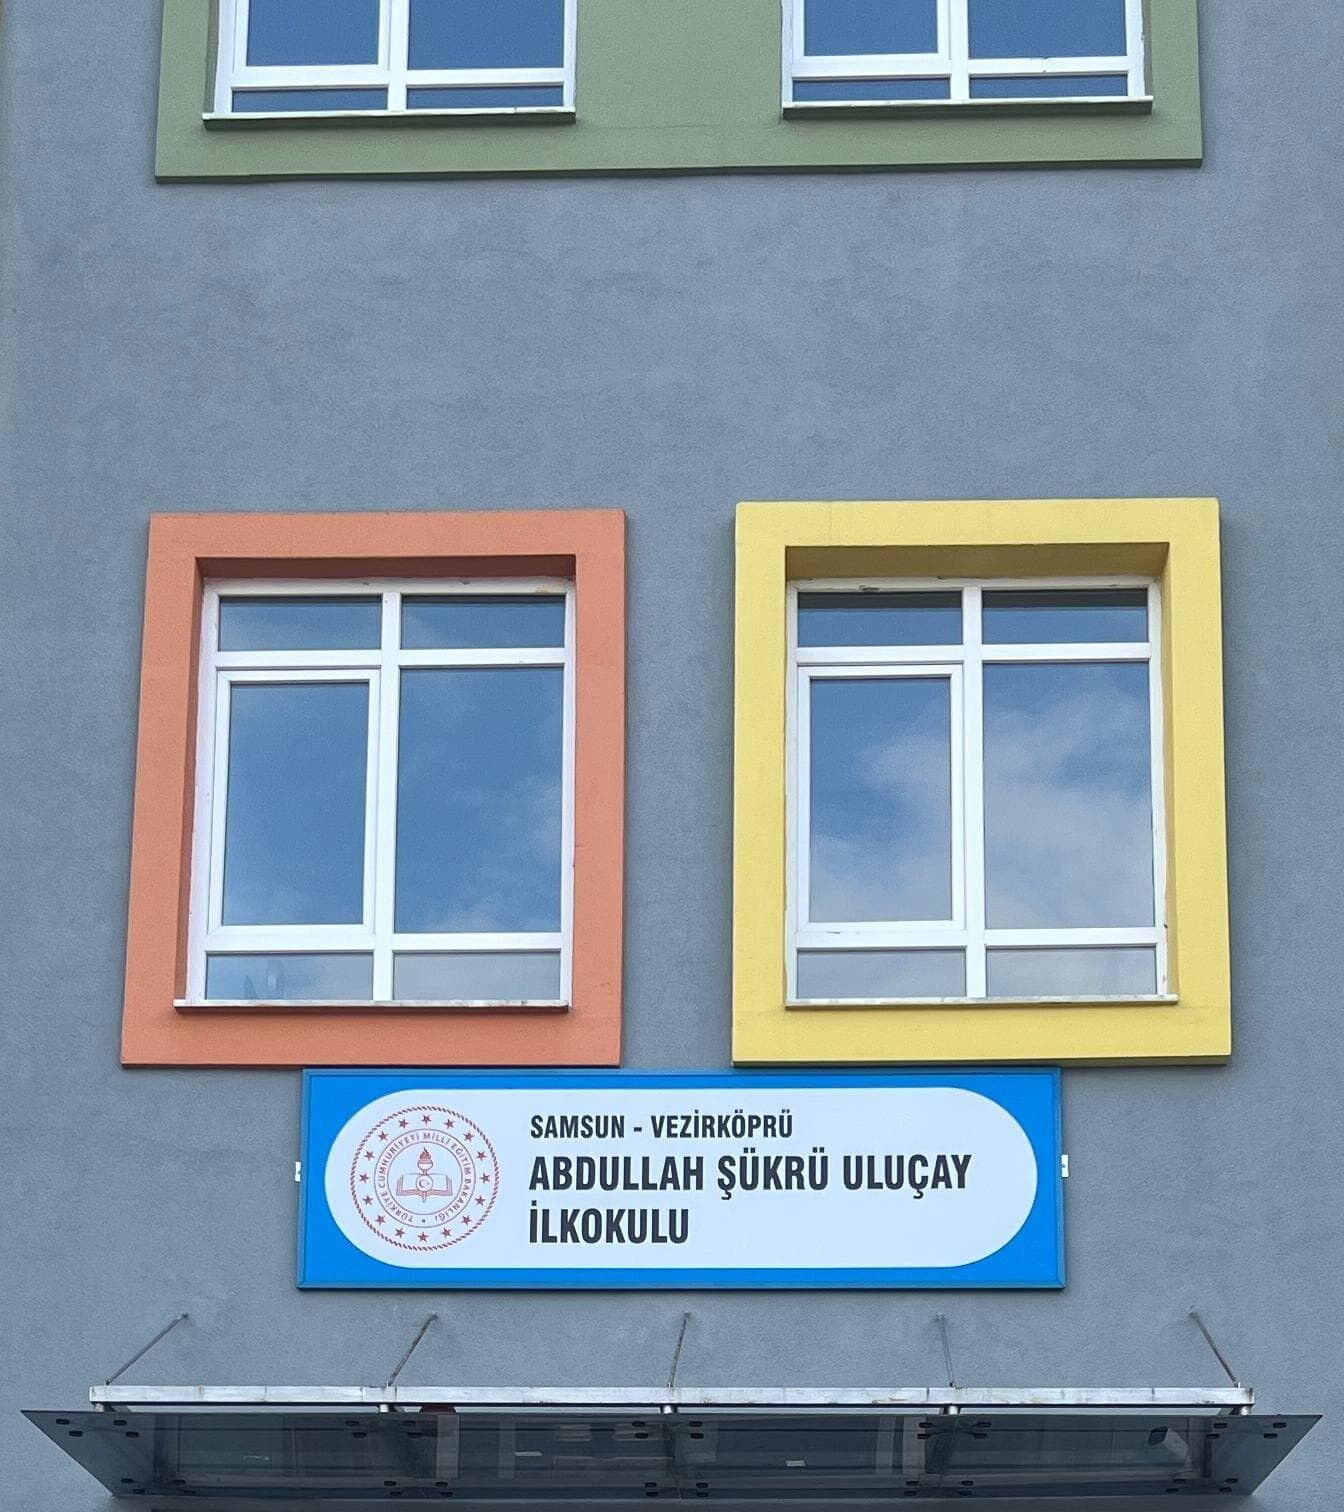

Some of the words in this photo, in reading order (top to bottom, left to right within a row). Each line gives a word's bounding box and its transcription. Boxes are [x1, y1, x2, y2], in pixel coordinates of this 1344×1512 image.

[530, 1114, 625, 1139] SAMSUN
[650, 1108, 793, 1139] VEZİRKÖPRÜ
[378, 1133, 420, 1189] CUMHURİYETİ
[451, 1142, 472, 1175] EĞİTİM
[528, 1155, 704, 1192] ABDULLAH
[717, 1146, 829, 1201] ŞÜKRÜ
[843, 1153, 973, 1200] ULUÇAY
[380, 1190, 413, 1223] TÜRKİYE
[434, 1178, 472, 1223] BAKANLIĞI
[528, 1199, 690, 1245] İLKOKULU
